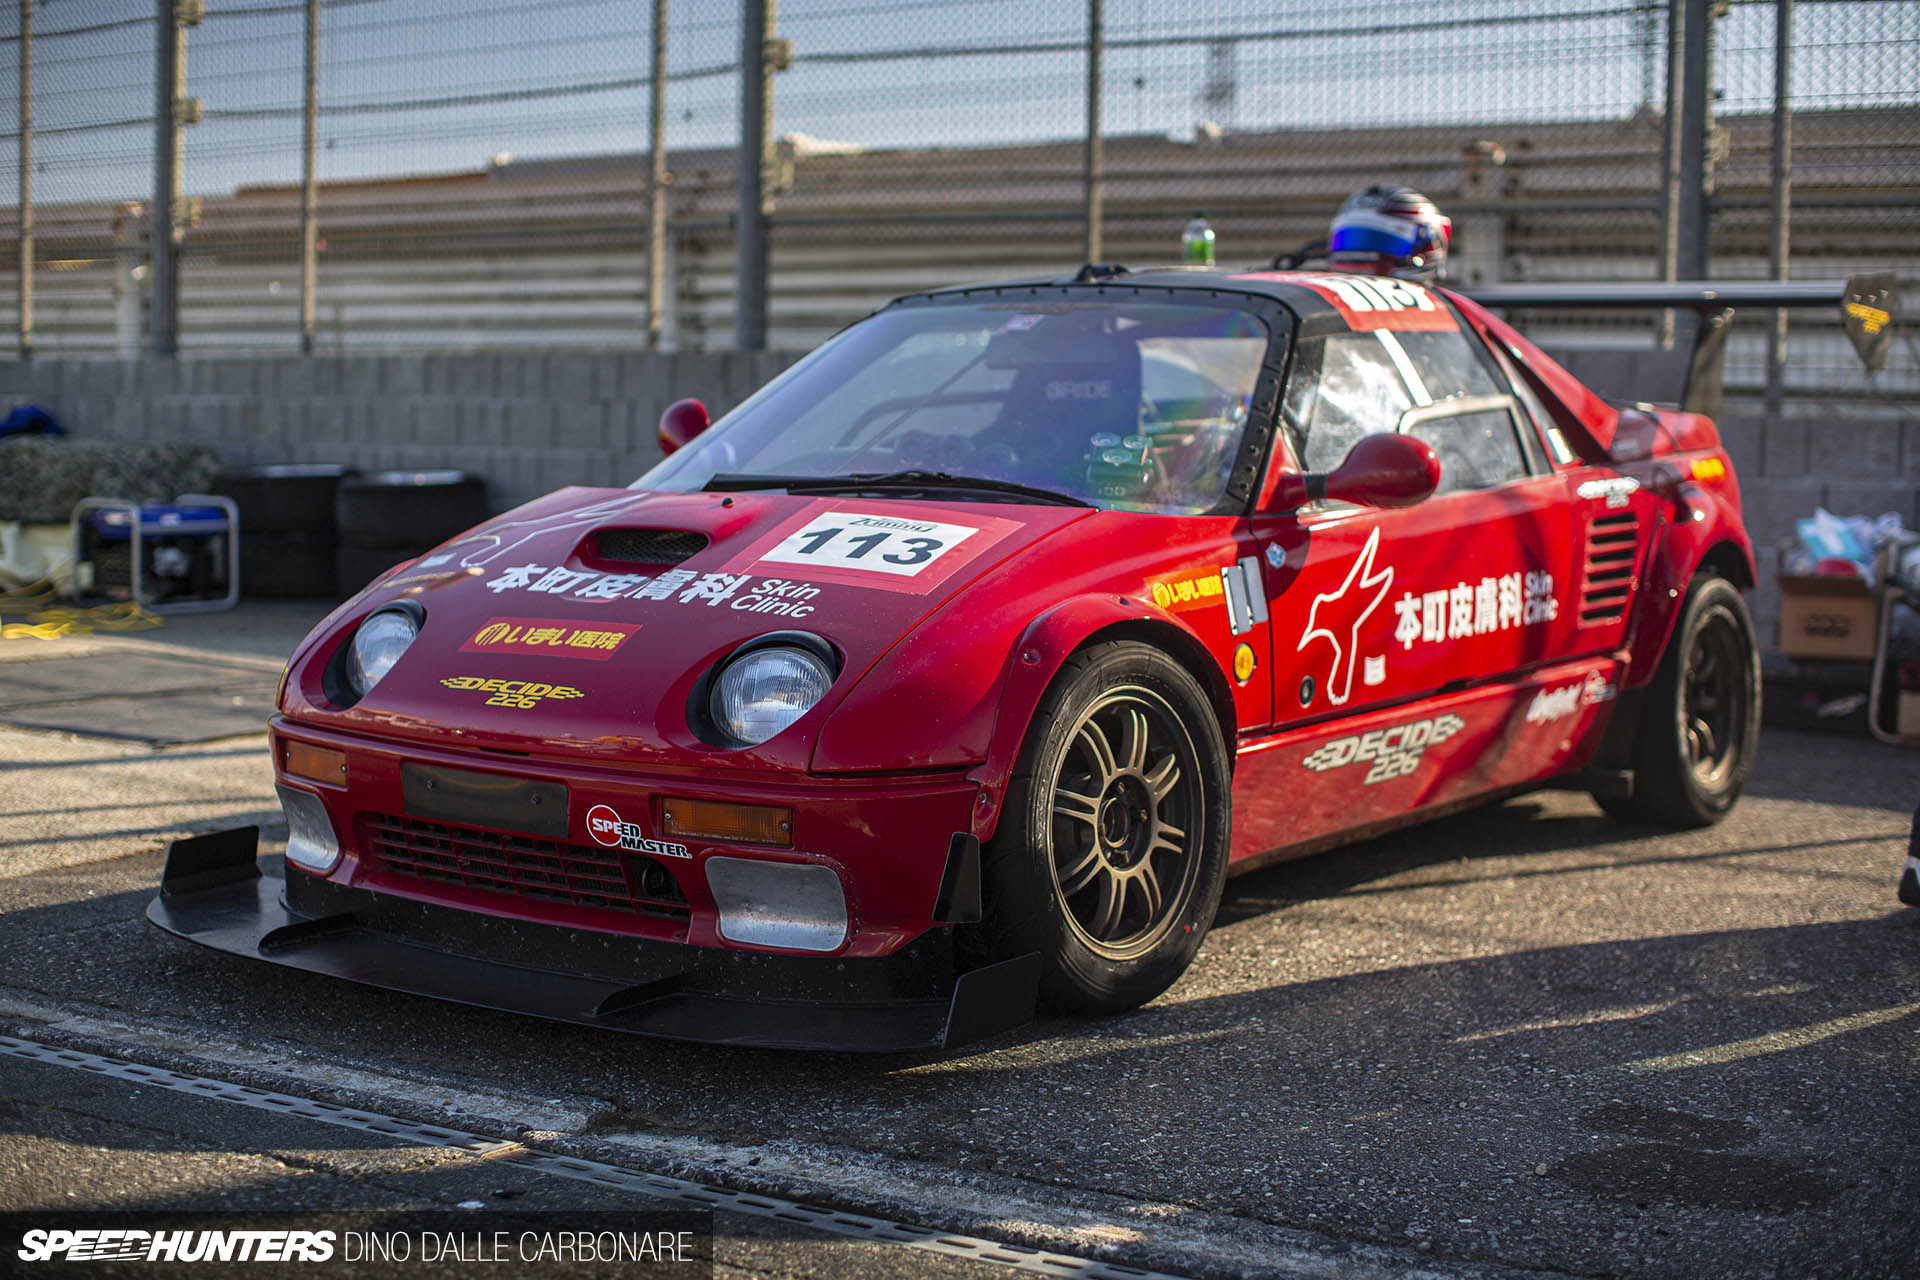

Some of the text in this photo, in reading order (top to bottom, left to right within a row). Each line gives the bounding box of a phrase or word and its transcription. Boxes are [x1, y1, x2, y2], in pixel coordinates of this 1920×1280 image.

[797, 528, 943, 565] 113
[486, 563, 752, 606] 本町皮膚科
[752, 579, 821, 600] Skin
[731, 594, 815, 618] Clinic
[504, 625, 626, 650] いまい医院
[447, 675, 580, 700] DECIDE
[484, 692, 542, 709] 226
[1314, 714, 1461, 772] DECIDE
[1362, 748, 1425, 786] 226
[592, 818, 640, 838] SPEED
[621, 837, 688, 857] MASTER
